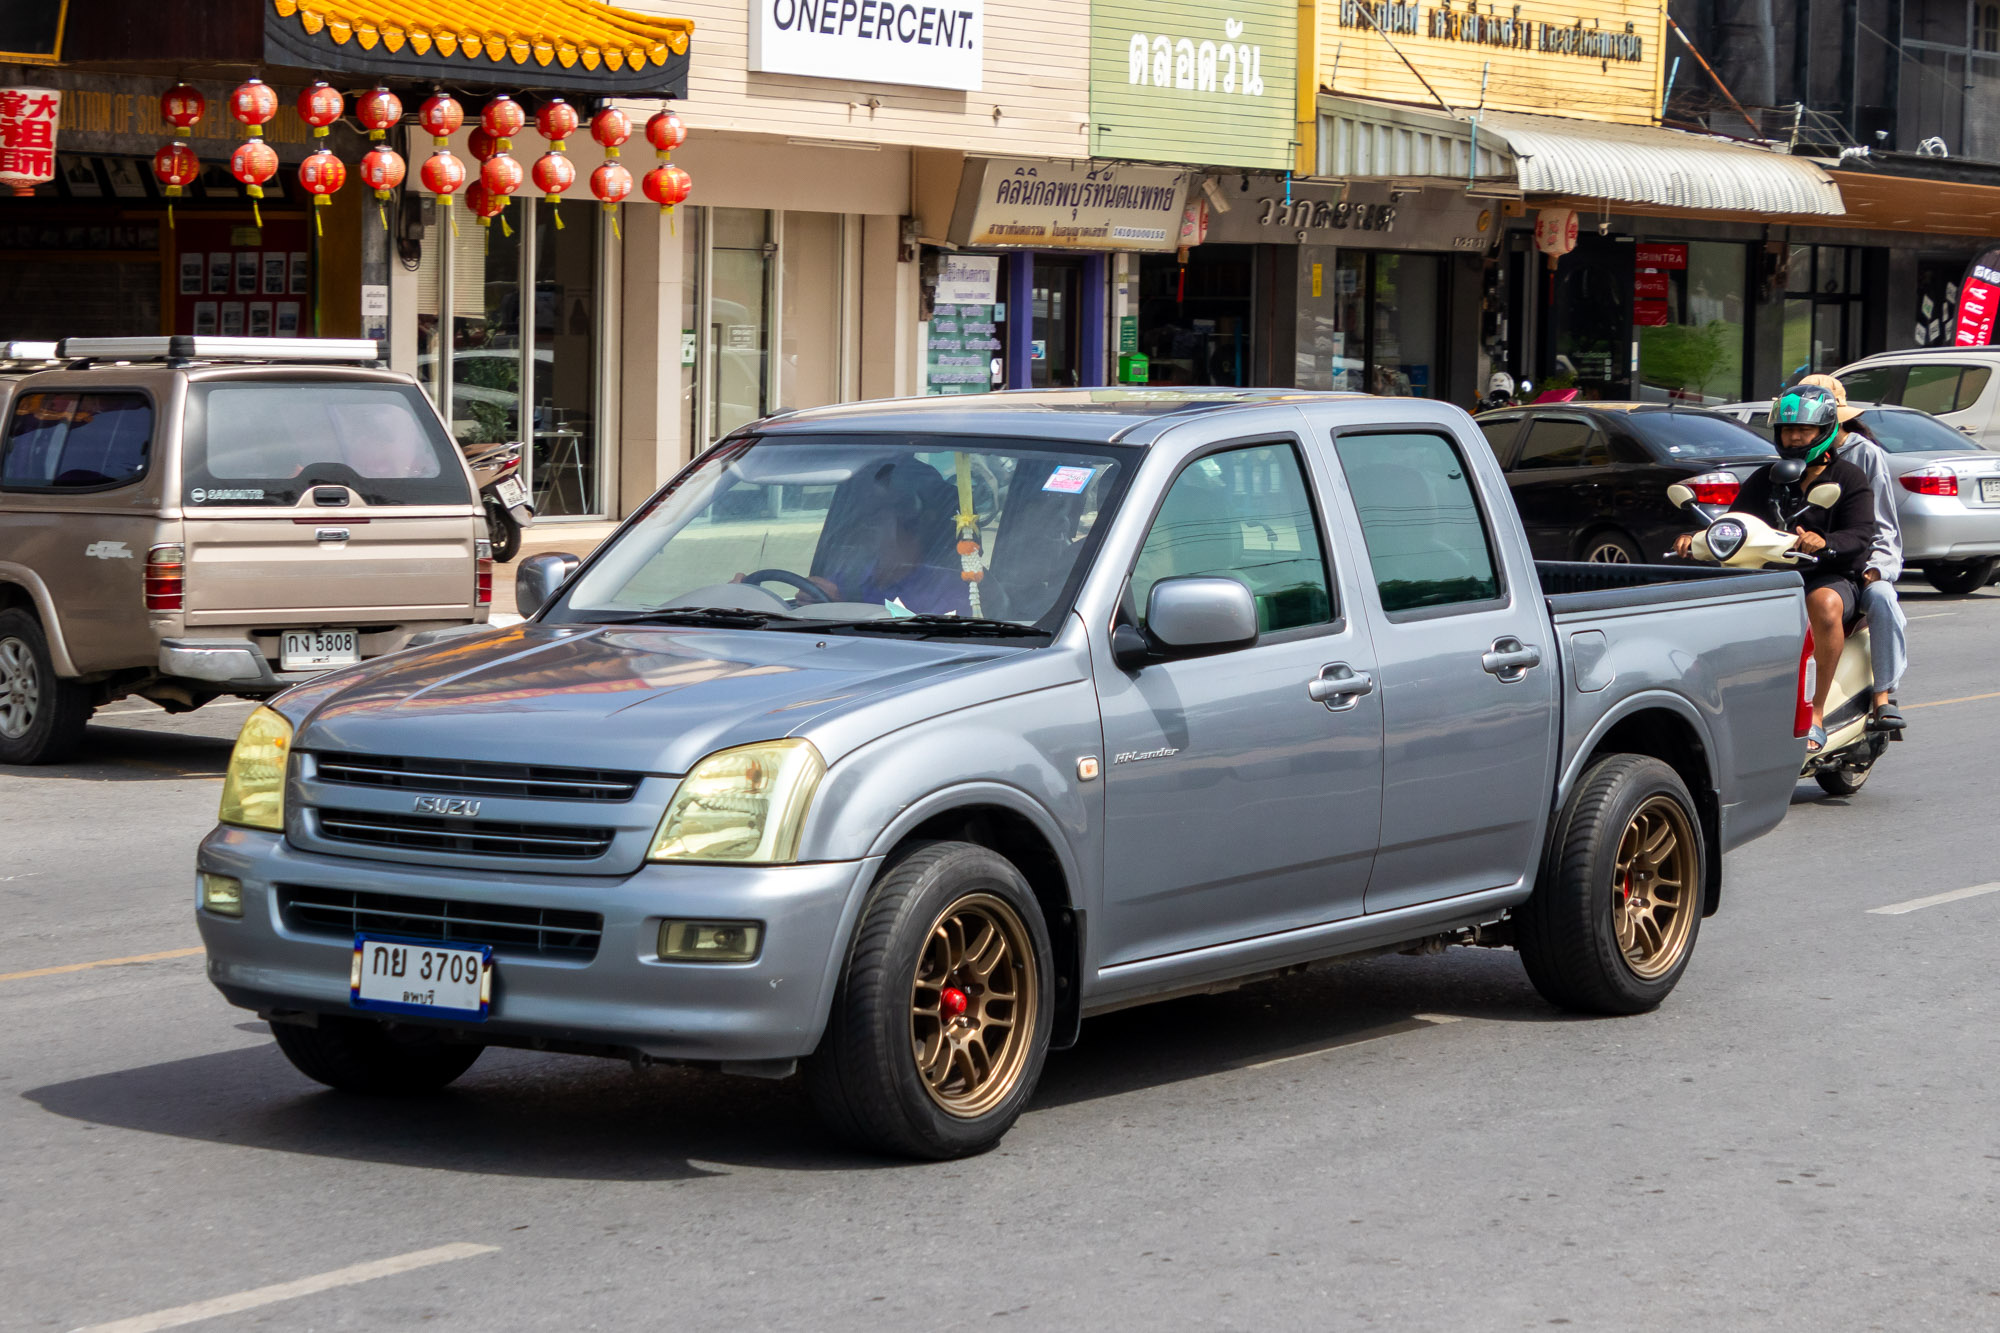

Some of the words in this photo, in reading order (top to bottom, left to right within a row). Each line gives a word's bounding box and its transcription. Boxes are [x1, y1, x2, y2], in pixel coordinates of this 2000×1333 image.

[773, 0, 973, 49] ONEPERCENT.
[1129, 17, 1264, 96] ตลอดวัน
[115, 93, 134, 133] OF
[996, 167, 1181, 221] คลินิกลพบุรีทันตแพทย์
[207, 489, 265, 500] SAMMITR
[316, 634, 352, 651] 5808
[415, 796, 481, 816] ISUZU
[373, 946, 407, 977] กย
[420, 951, 478, 984] 3709
